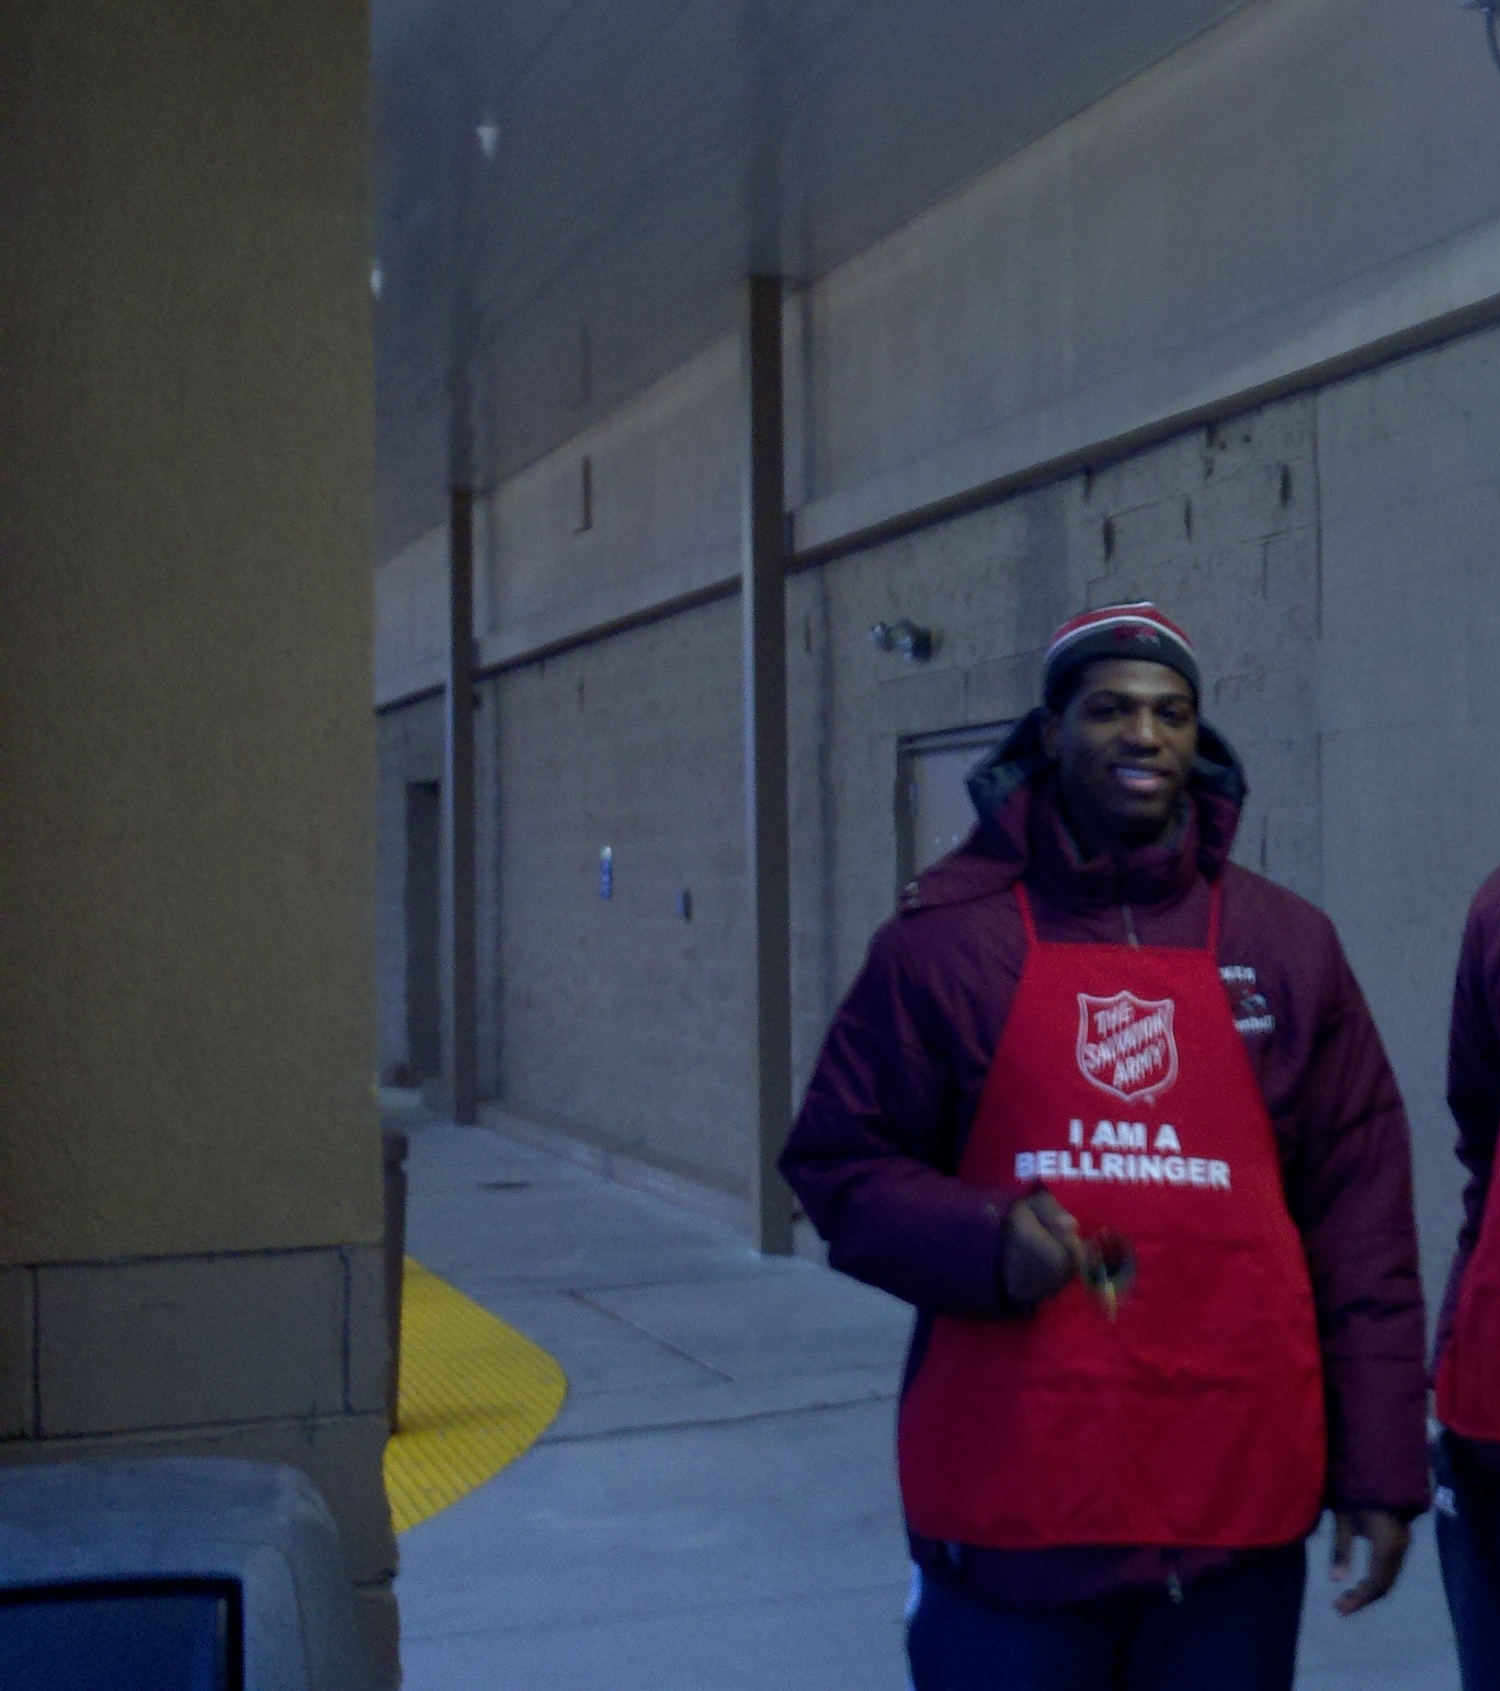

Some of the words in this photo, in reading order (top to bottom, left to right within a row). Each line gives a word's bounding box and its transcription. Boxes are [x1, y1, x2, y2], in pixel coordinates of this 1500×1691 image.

[1069, 1118, 1083, 1149] I
[1090, 1119, 1148, 1151] AM
[1154, 1122, 1183, 1152] A
[1014, 1150, 1231, 1190] BELLRINGER
